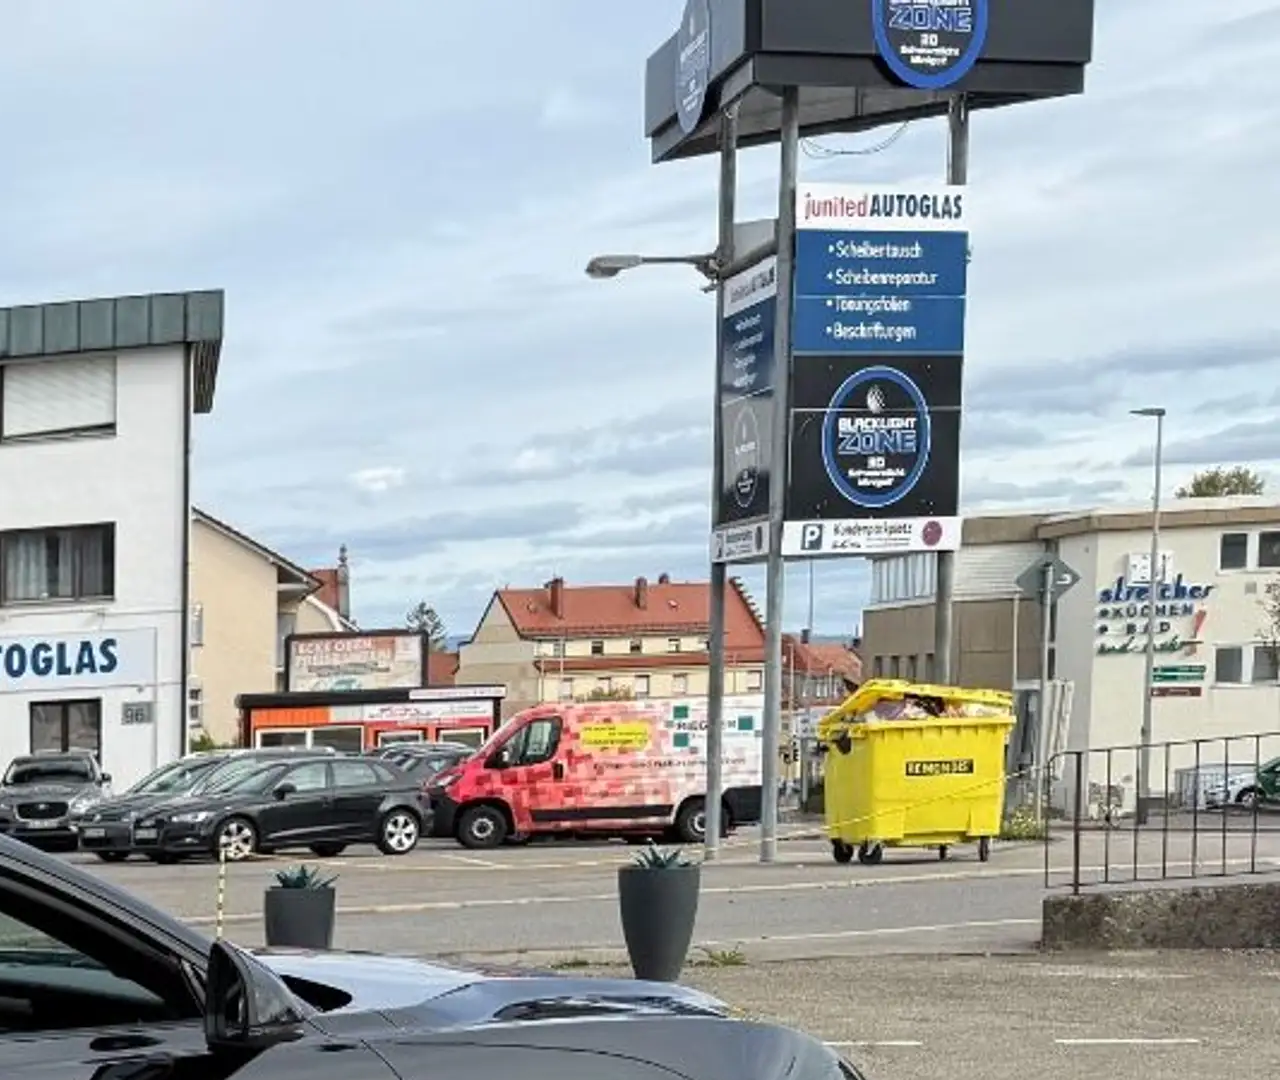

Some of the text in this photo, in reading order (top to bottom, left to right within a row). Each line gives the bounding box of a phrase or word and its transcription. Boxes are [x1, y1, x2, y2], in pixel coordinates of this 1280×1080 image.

[888, 4, 972, 32] ZONE
[838, 429, 917, 455] ZONE
[1099, 573, 1214, 602] strecher
